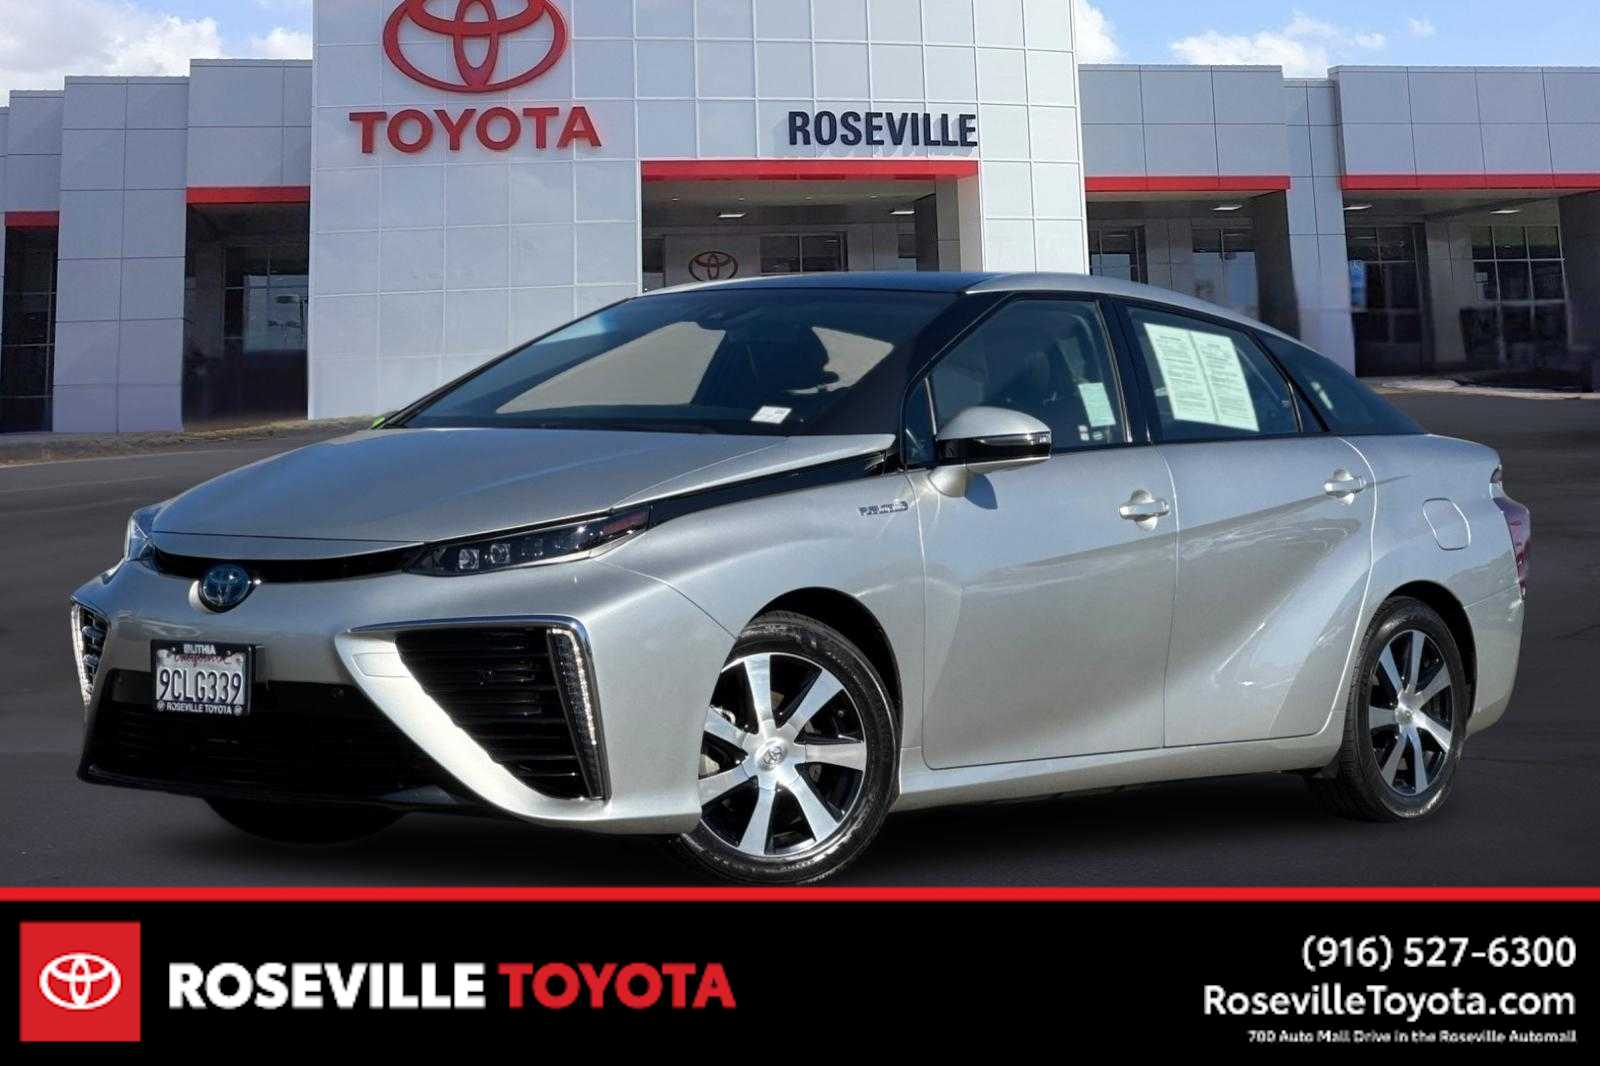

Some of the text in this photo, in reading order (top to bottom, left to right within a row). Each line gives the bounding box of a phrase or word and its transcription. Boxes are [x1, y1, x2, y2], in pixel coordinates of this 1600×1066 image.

[349, 105, 603, 154] TOYOTA
[788, 110, 978, 147] ROSEVILLE
[159, 668, 242, 704] 9CLG339
[166, 701, 233, 715] ROSEVILLE TOYOTA
